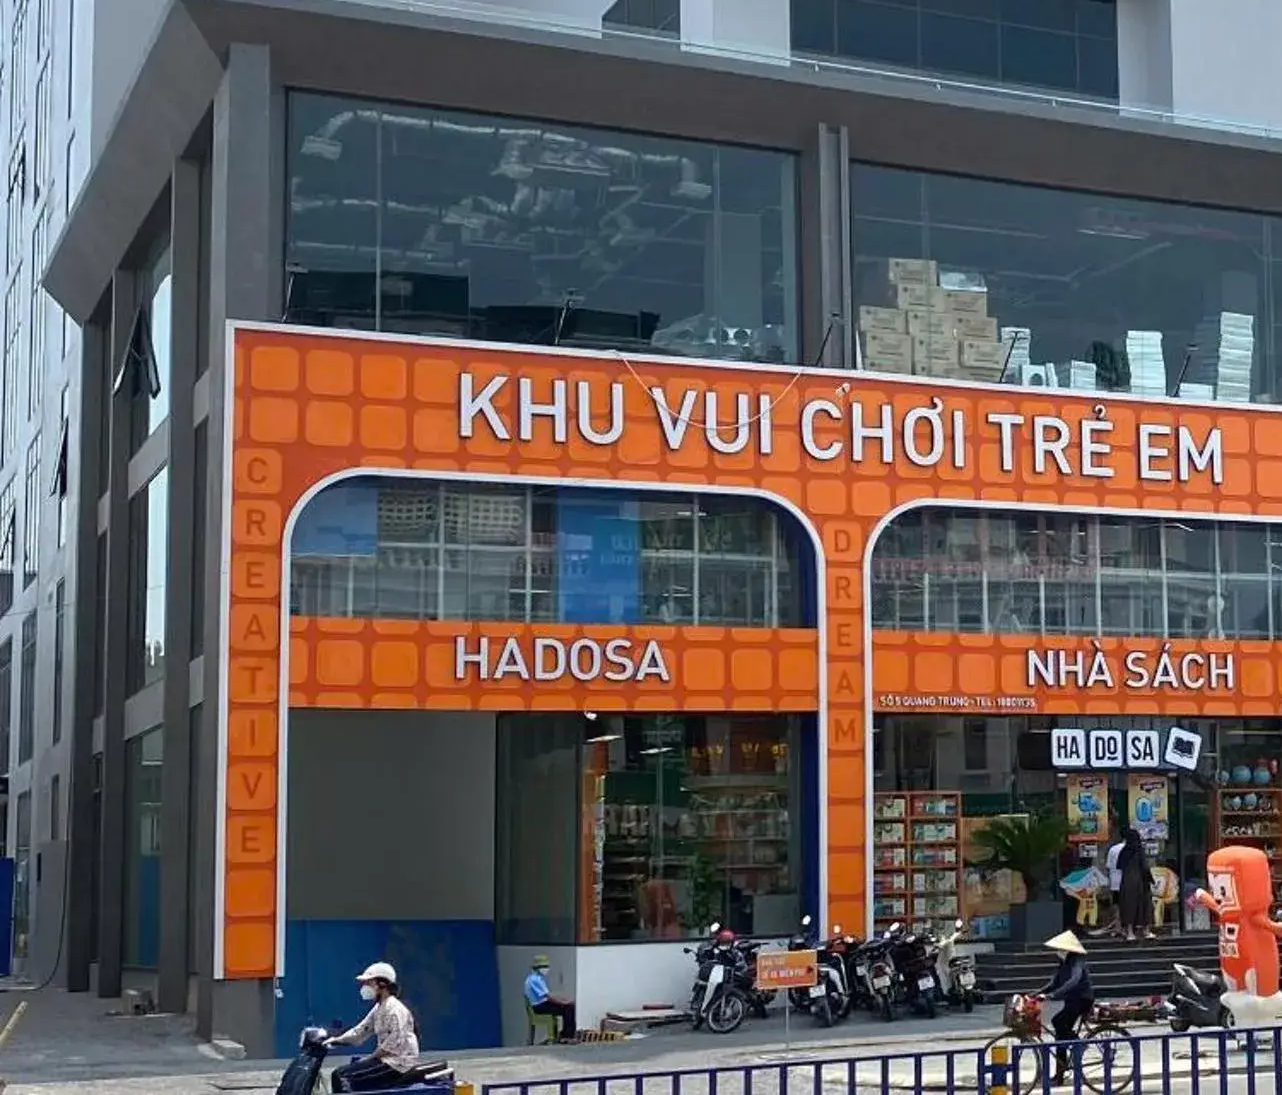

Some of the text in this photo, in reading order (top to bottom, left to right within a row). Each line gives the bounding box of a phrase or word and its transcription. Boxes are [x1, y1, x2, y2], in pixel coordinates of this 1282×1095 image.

[458, 372, 1224, 485] KHU VUI CHƠI TRẺ EM
[240, 457, 282, 853] CREATIVE
[455, 635, 670, 683] HADOSA
[832, 528, 858, 743] DREAM
[1027, 641, 1235, 690] NHÀ SÁCH
[1057, 735, 1081, 758] HA
[1131, 736, 1154, 761] SA
